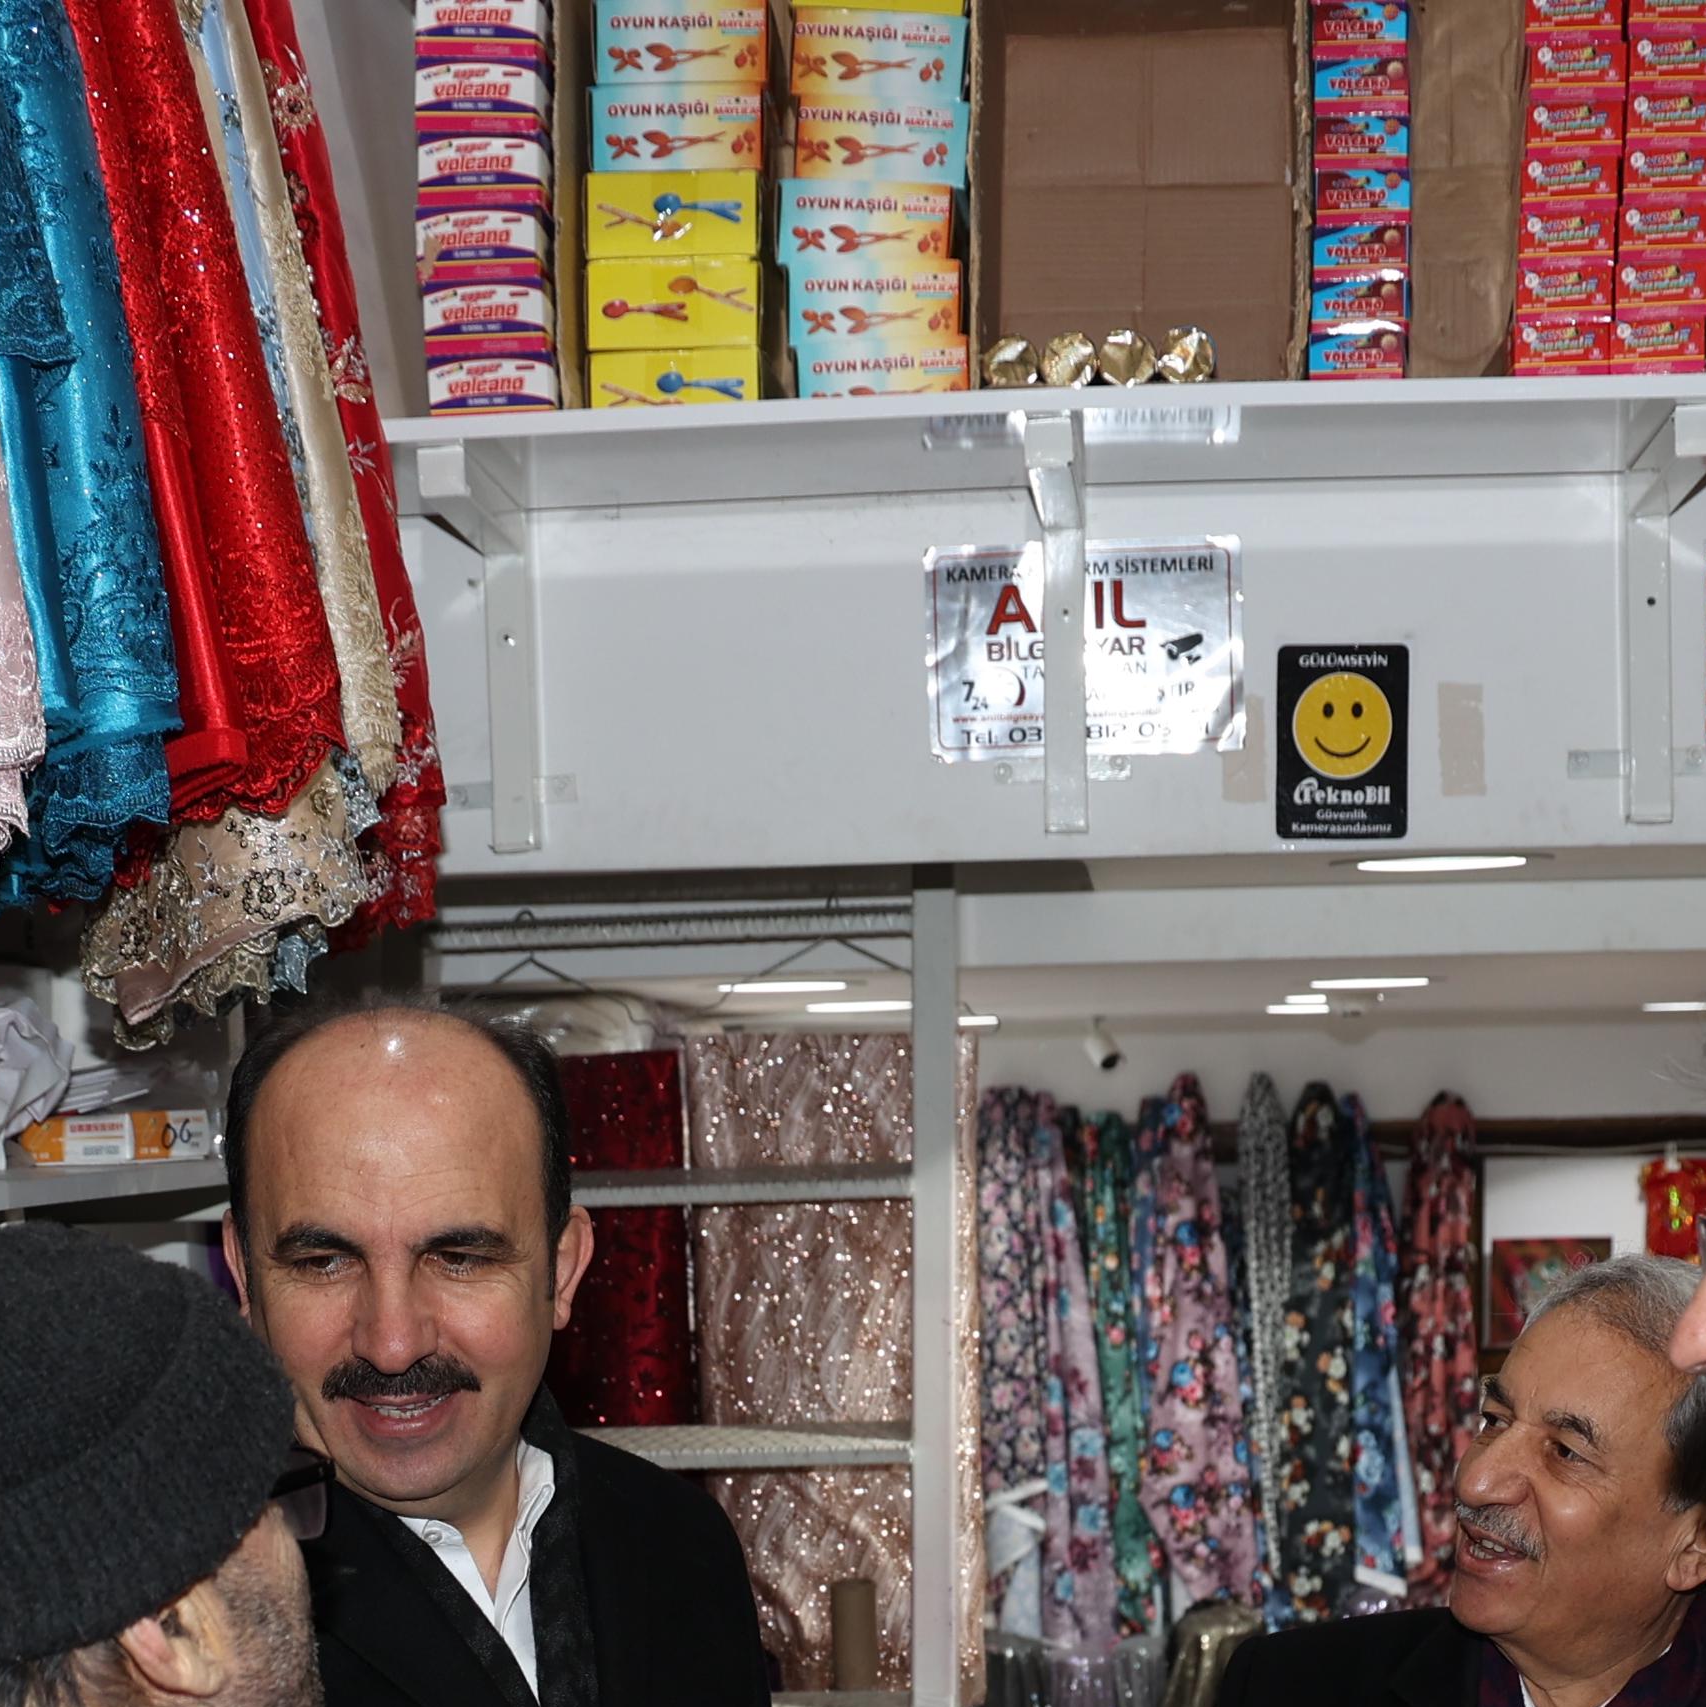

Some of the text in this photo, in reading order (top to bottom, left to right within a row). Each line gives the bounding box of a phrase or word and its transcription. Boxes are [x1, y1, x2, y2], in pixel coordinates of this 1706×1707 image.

[611, 15, 713, 32] OYUN KAŞIĞI
[795, 23, 897, 42] OYUN KAŞIĞI
[608, 101, 710, 119] OYUN KAŞIĞI
[799, 107, 901, 127] OYUN KAŞIĞI
[797, 196, 897, 213] OYUN KAŞIĞI
[805, 277, 906, 294] OYUN KAŞIĞI
[813, 357, 914, 375] OYUN KAŞIĞI
[1115, 553, 1214, 574] SİSTEMLERİ
[986, 578, 1146, 635] AIL
[987, 634, 1145, 661] BİLGYAR
[1298, 651, 1389, 668] GÜLÜMSEYİN
[1316, 808, 1368, 820] Güvenlik
